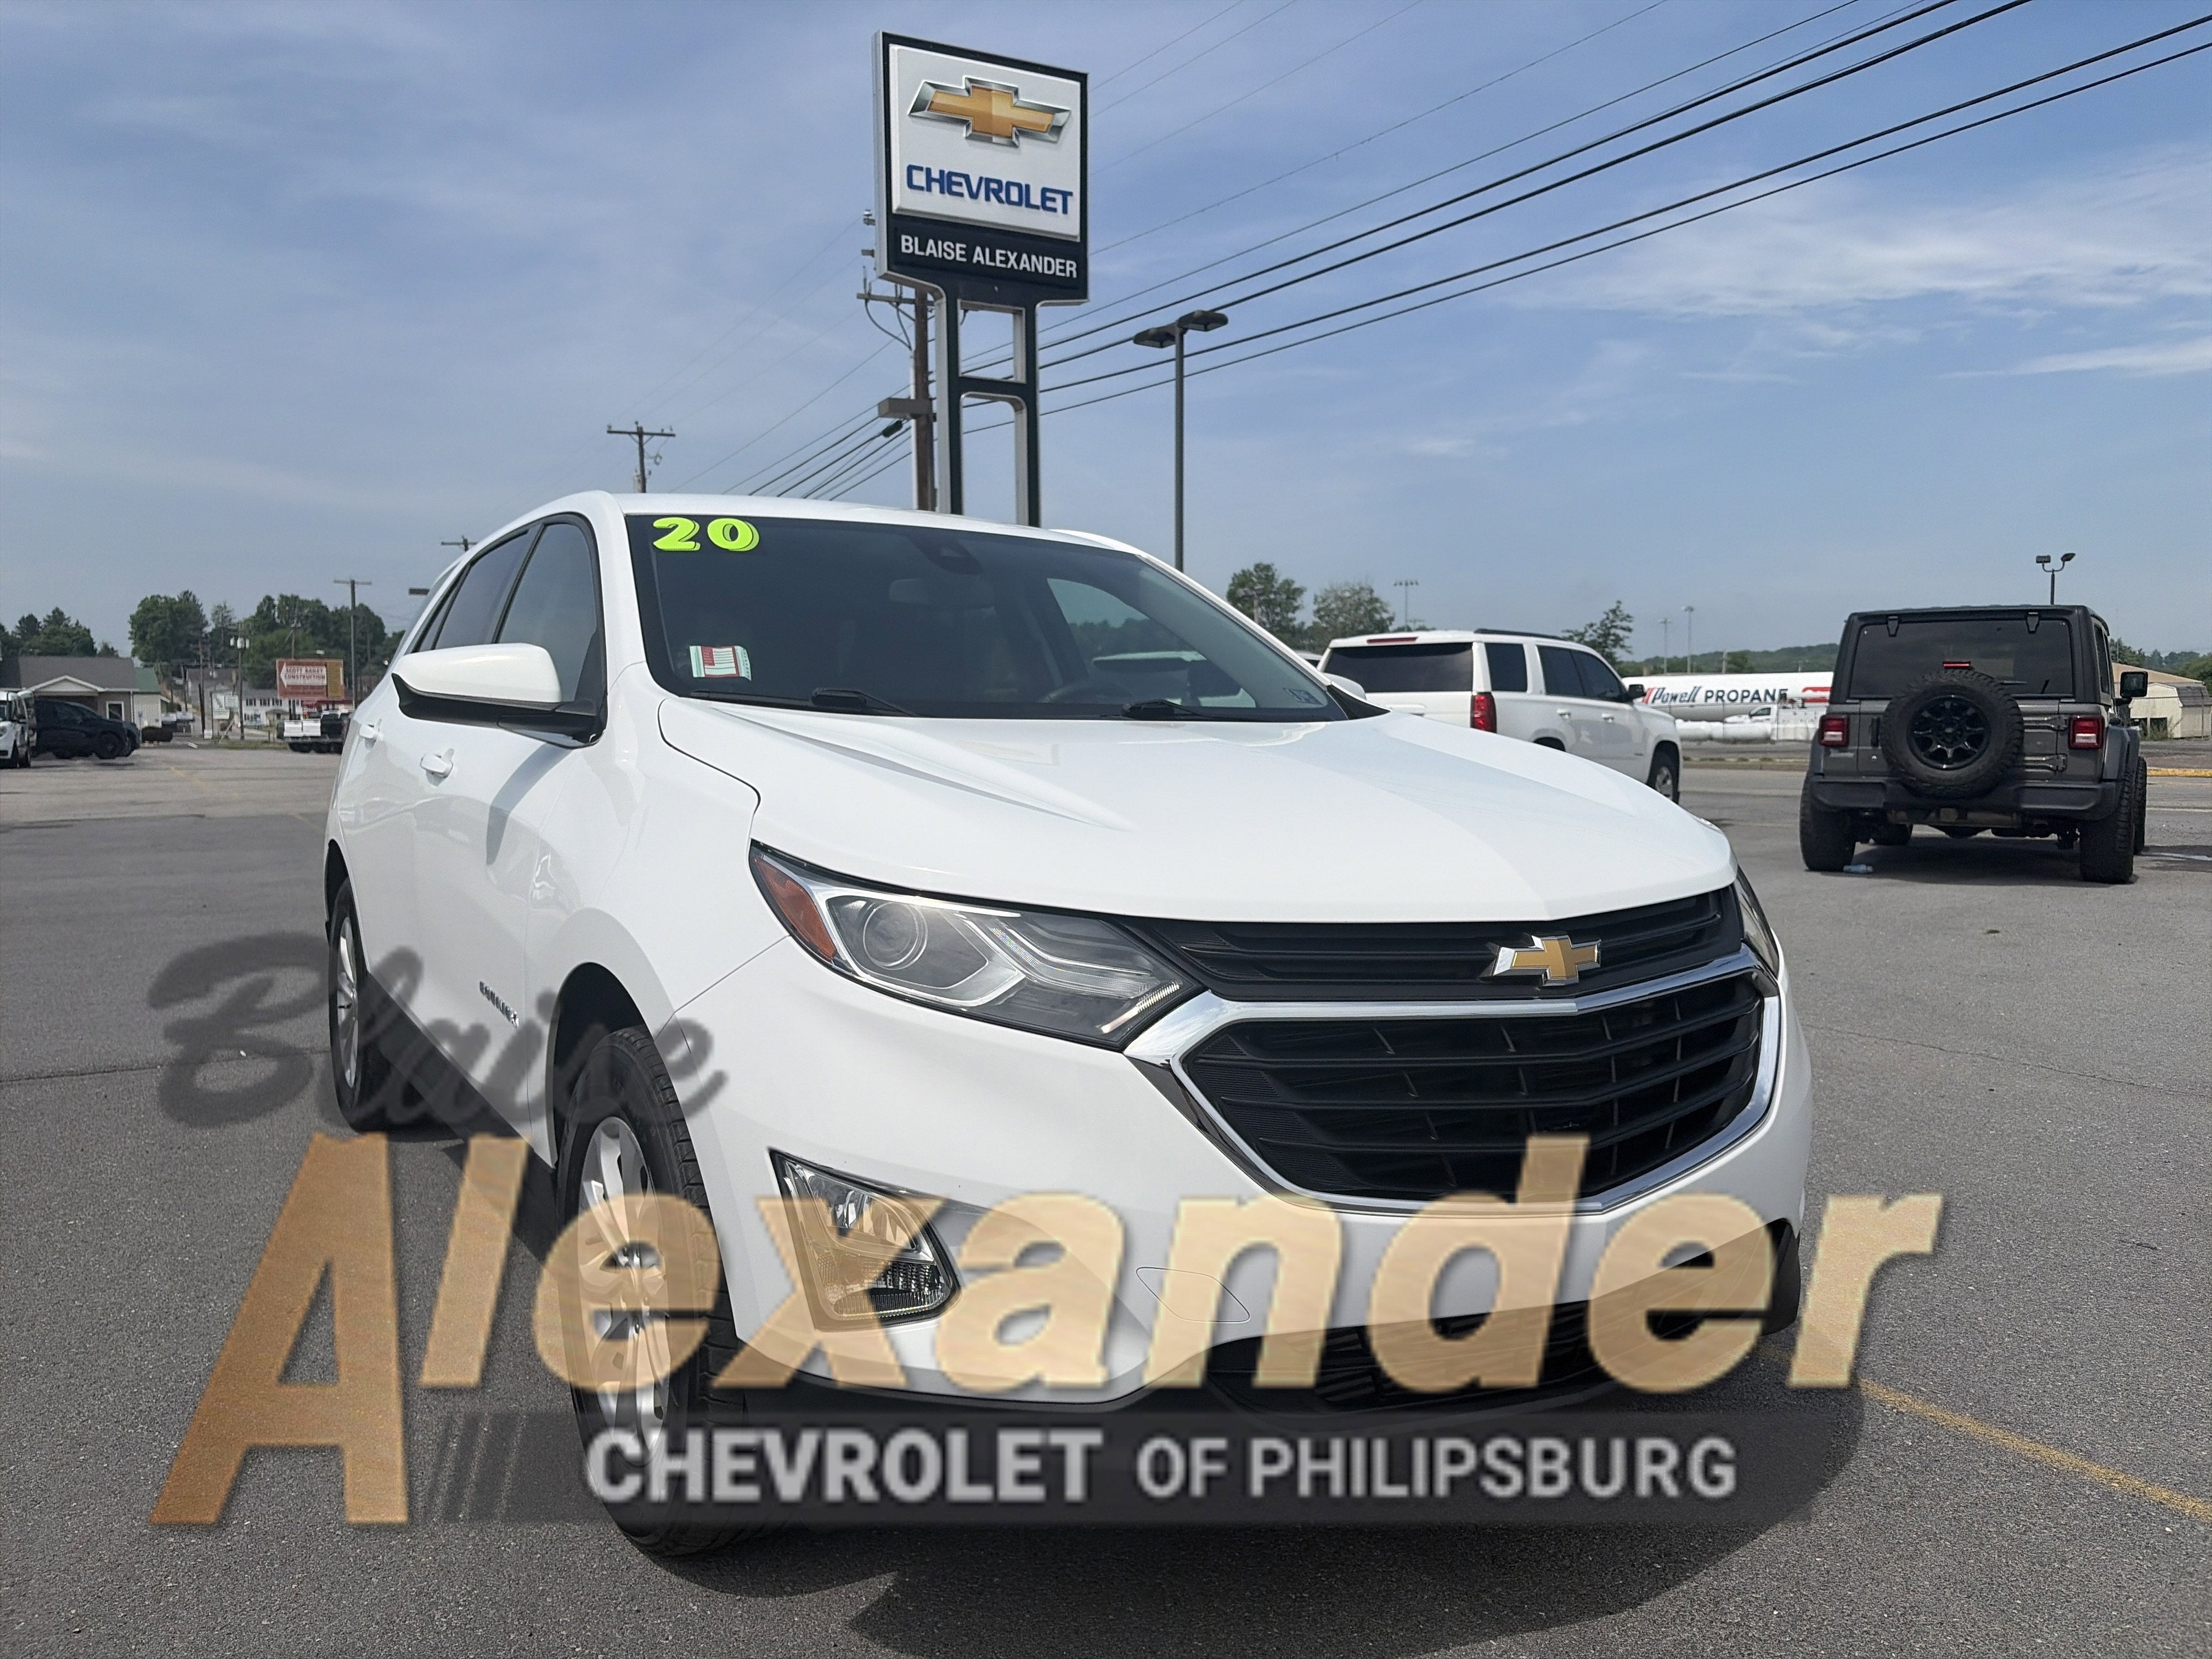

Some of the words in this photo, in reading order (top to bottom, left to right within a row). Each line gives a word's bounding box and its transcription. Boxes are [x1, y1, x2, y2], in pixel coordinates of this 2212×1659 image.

[906, 164, 1074, 215] CHEVROLET
[901, 234, 967, 262] BLAISE
[972, 246, 1077, 278] ALEXANDER
[653, 517, 760, 552] 20
[1650, 686, 1702, 704] Powell
[1704, 689, 1788, 703] PROPANE
